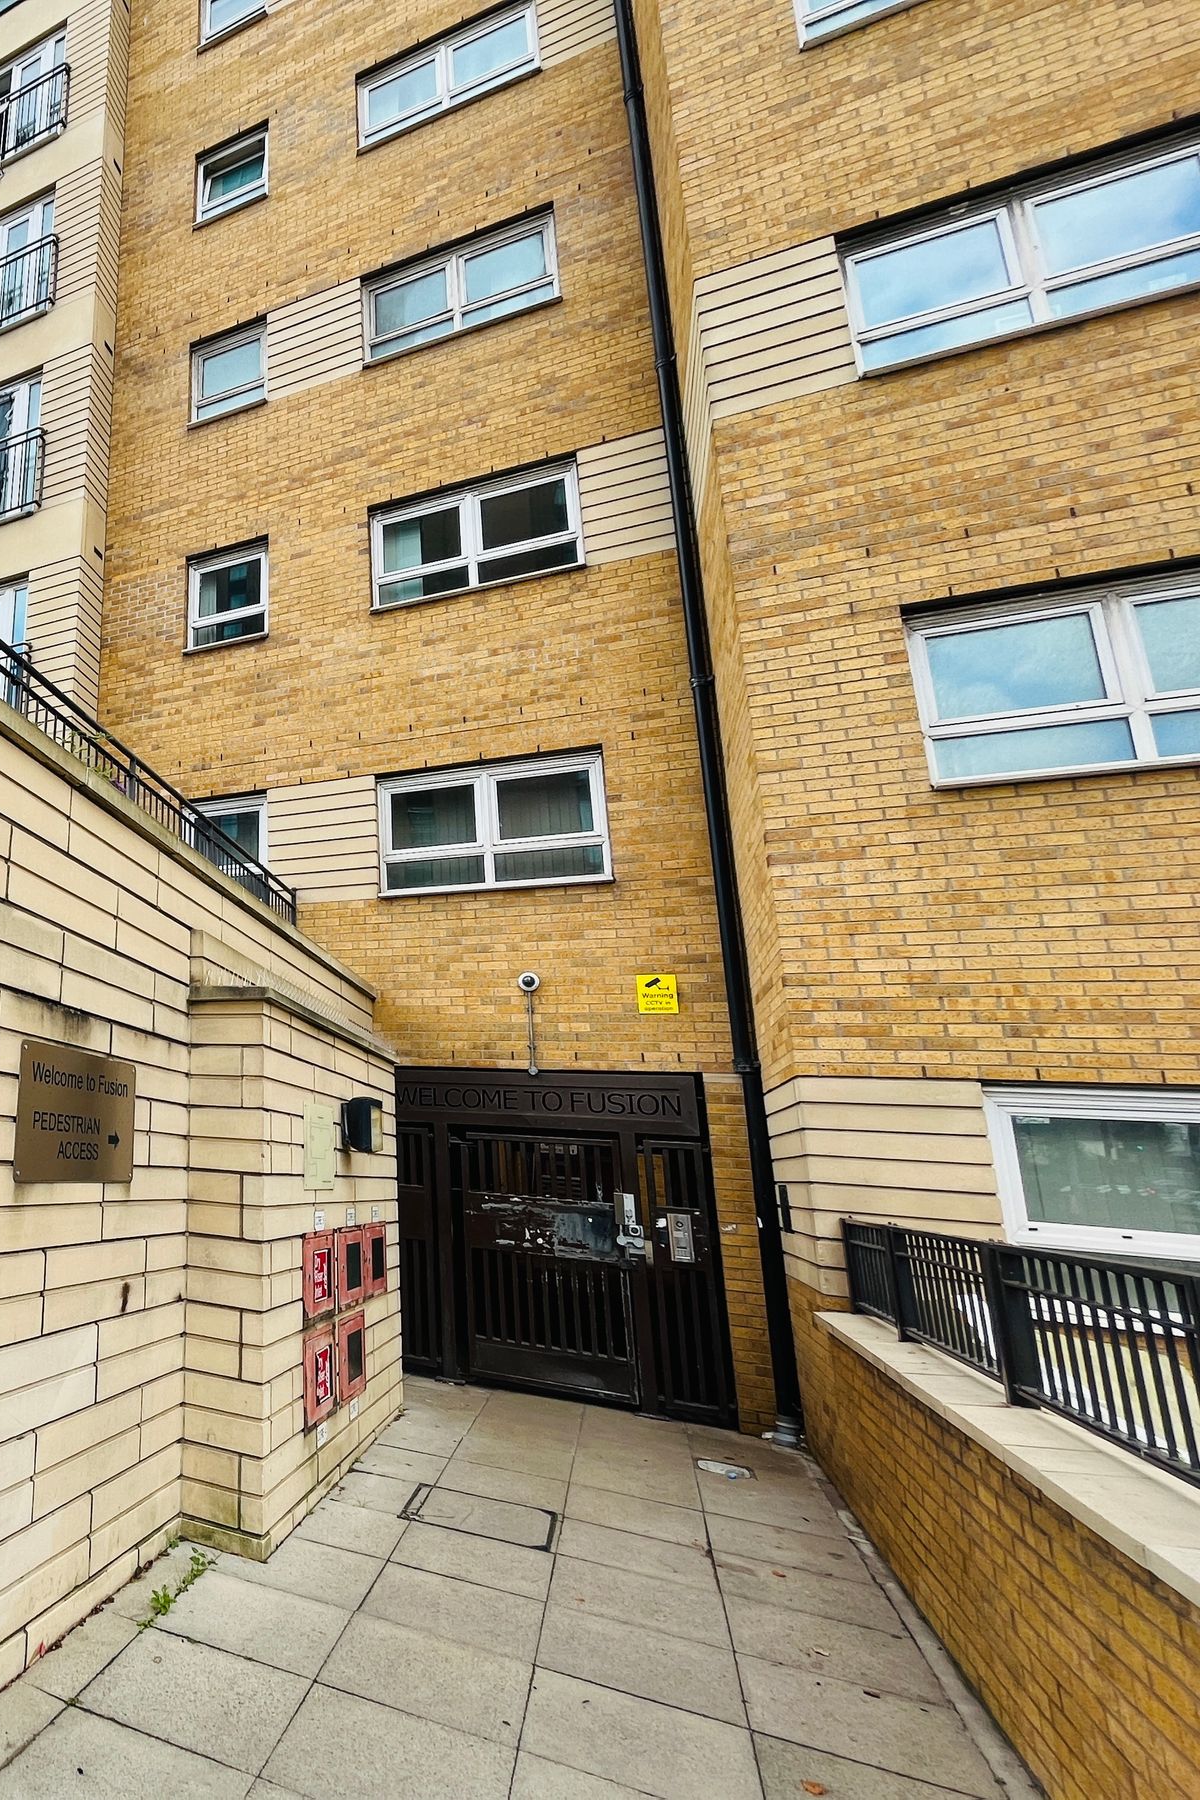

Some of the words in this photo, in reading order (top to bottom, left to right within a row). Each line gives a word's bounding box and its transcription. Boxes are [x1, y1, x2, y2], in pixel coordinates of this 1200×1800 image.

[642, 992, 674, 1000] Warning
[32, 1060, 83, 1090] Welcome
[86, 1073, 96, 1092] to
[98, 1075, 128, 1098] Fusion
[396, 1086, 519, 1110] WELCOME
[524, 1090, 563, 1112] TO
[570, 1091, 682, 1117] FUSION
[32, 1110, 101, 1136] PEDESTRIAN
[56, 1140, 99, 1161] ACCESS
